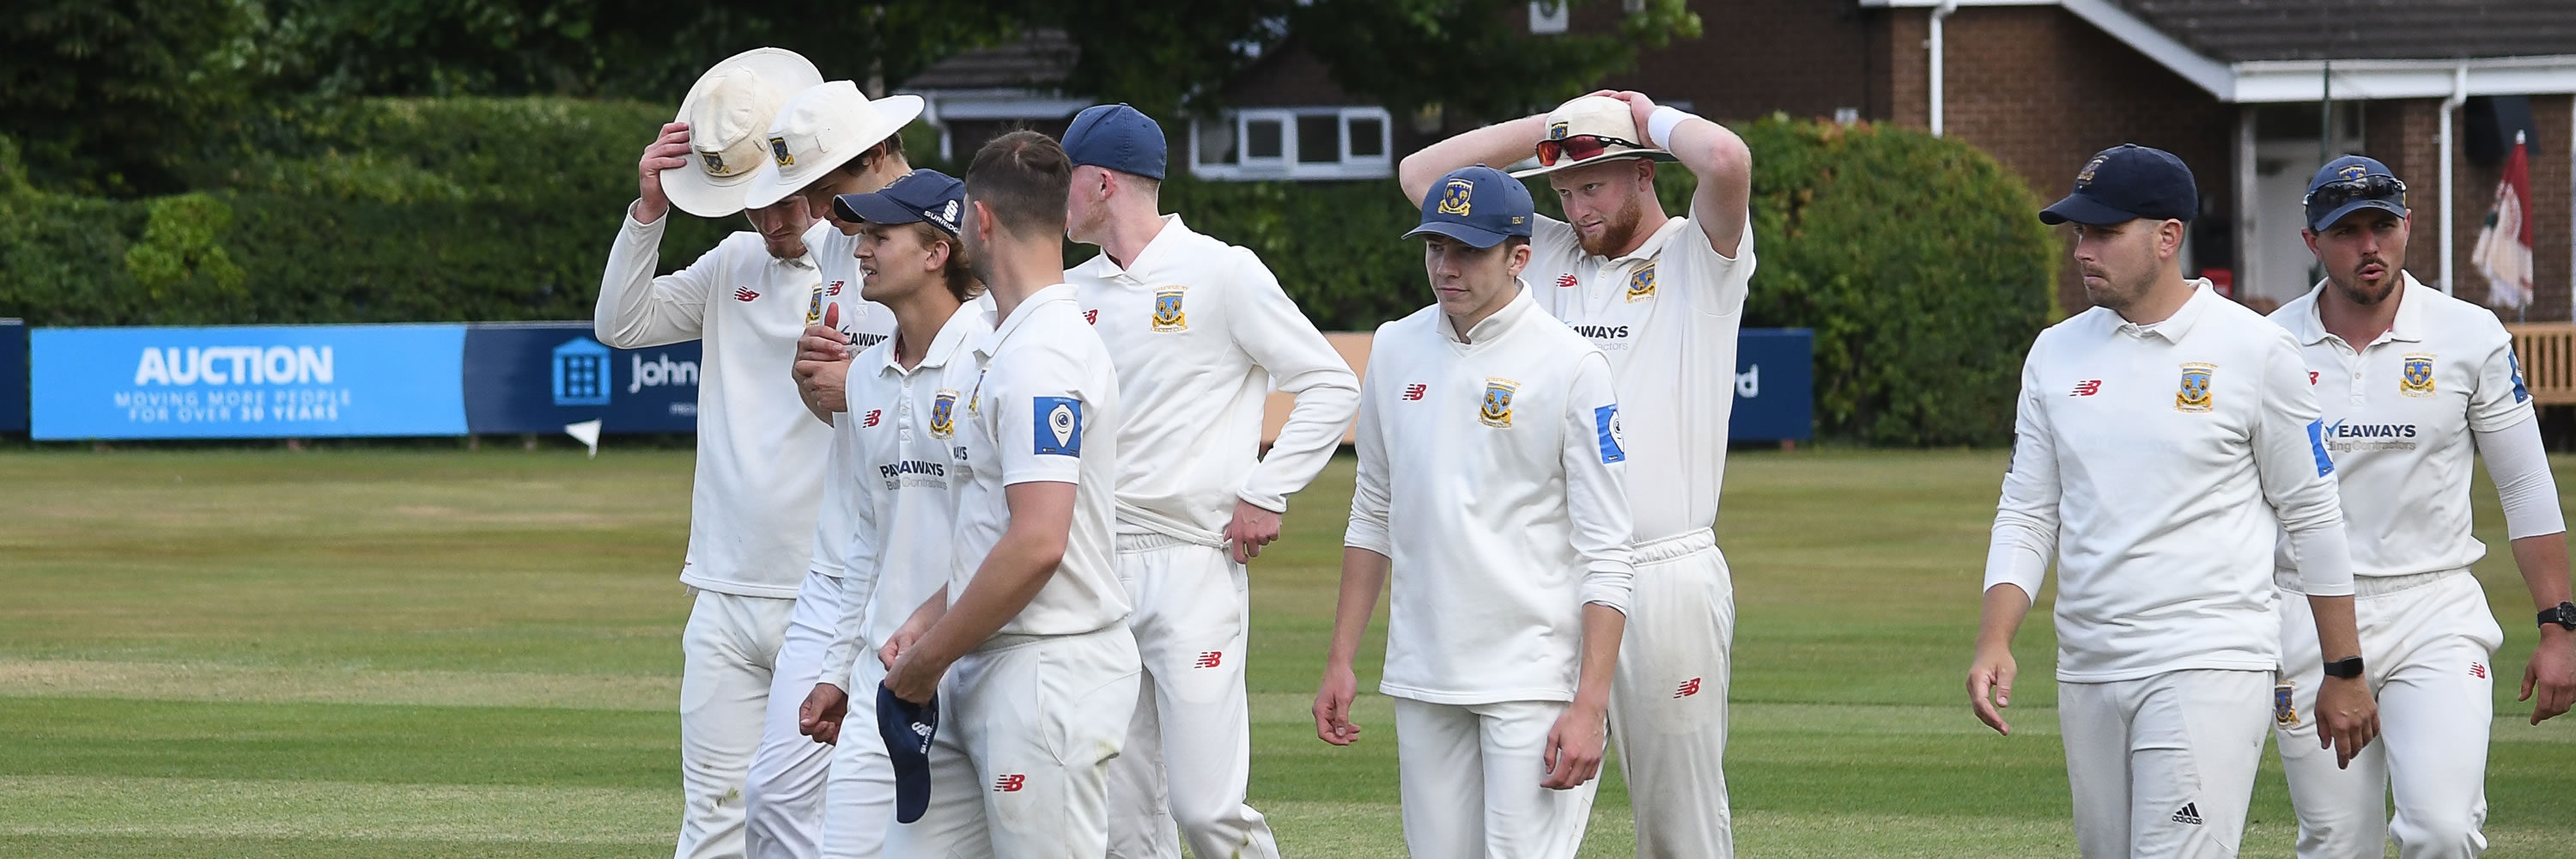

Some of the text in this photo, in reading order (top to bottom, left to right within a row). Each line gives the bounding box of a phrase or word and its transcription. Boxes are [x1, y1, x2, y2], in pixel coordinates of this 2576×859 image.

[135, 346, 334, 385] AUCTION
[628, 352, 699, 393] John
[114, 389, 350, 407] MOVING MORE PEOPLE
[130, 405, 169, 423] FOR
[178, 405, 232, 423] OVER
[273, 405, 339, 422] YEARS
